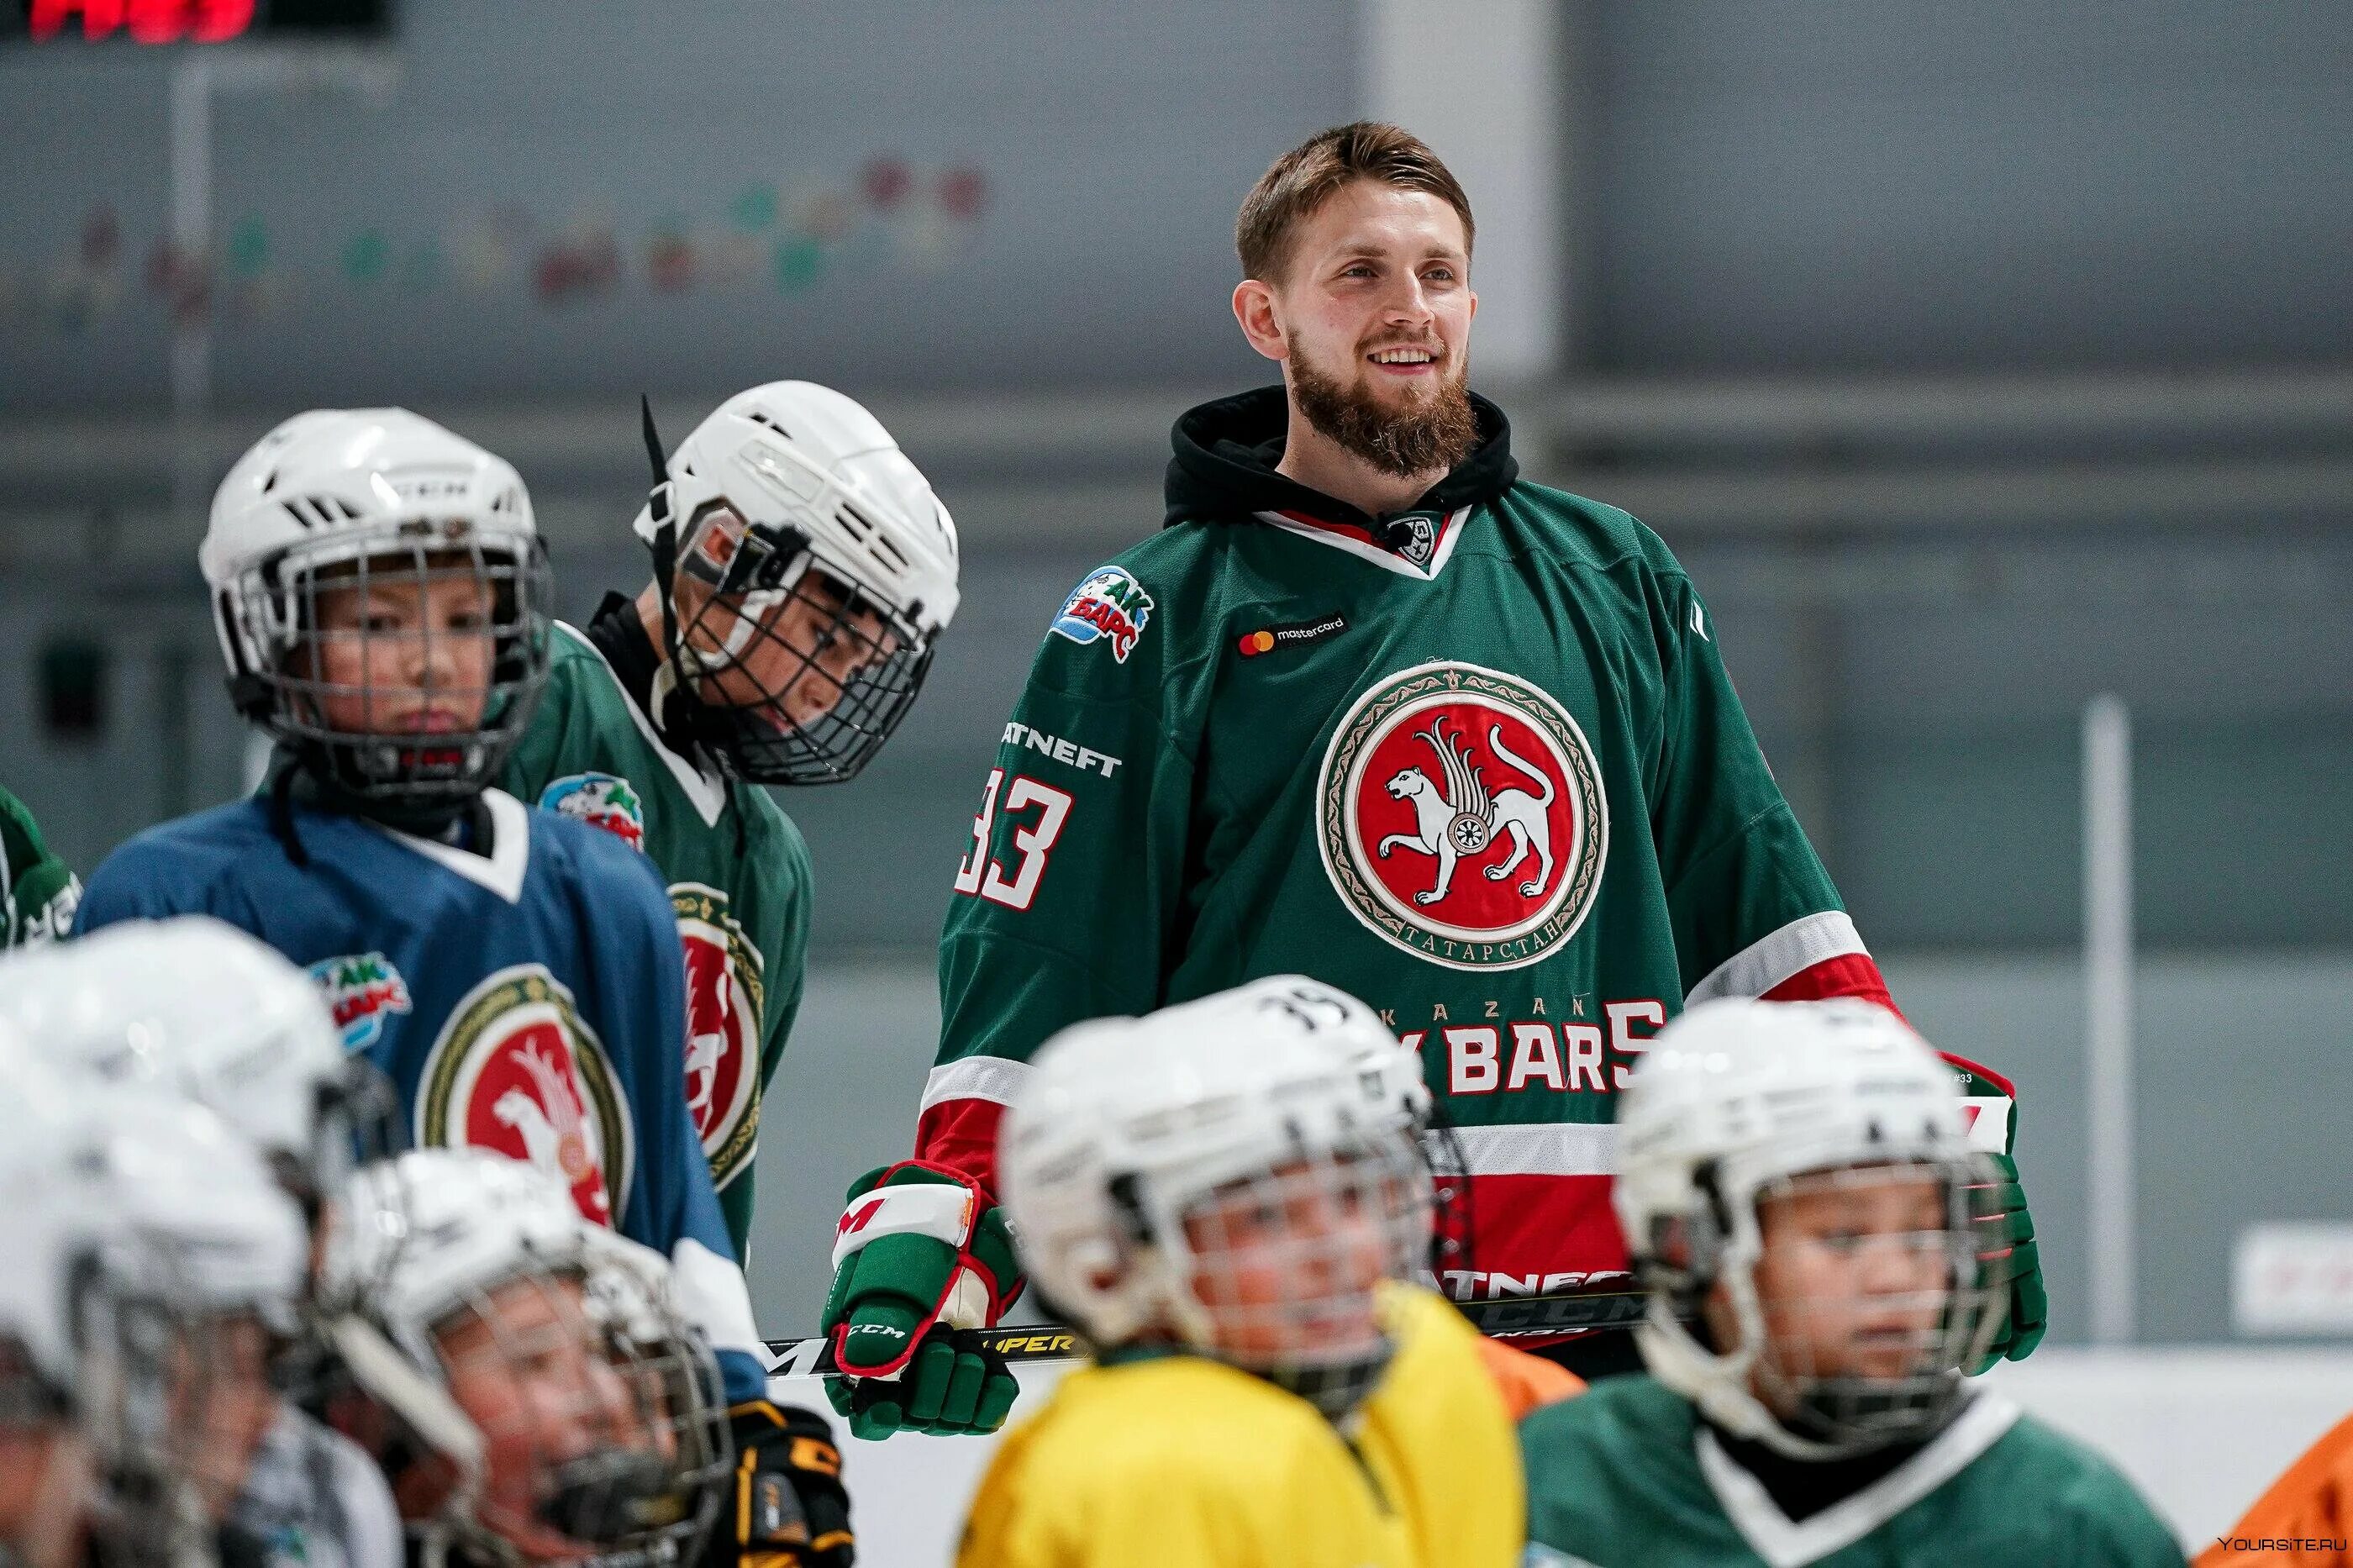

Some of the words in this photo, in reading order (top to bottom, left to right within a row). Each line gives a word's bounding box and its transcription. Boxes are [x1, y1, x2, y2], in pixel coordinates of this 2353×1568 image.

[1103, 579, 1151, 625] АК
[1069, 597, 1137, 660] БАРС
[1277, 618, 1344, 640] mastercard
[955, 767, 1076, 913] 33
[1405, 921, 1559, 960] ТАТАРСТАН
[1381, 997, 1585, 1026] KAZAN
[1441, 999, 1666, 1096] BARS
[1955, 1073, 1972, 1083] #33
[847, 1323, 906, 1339] CCM
